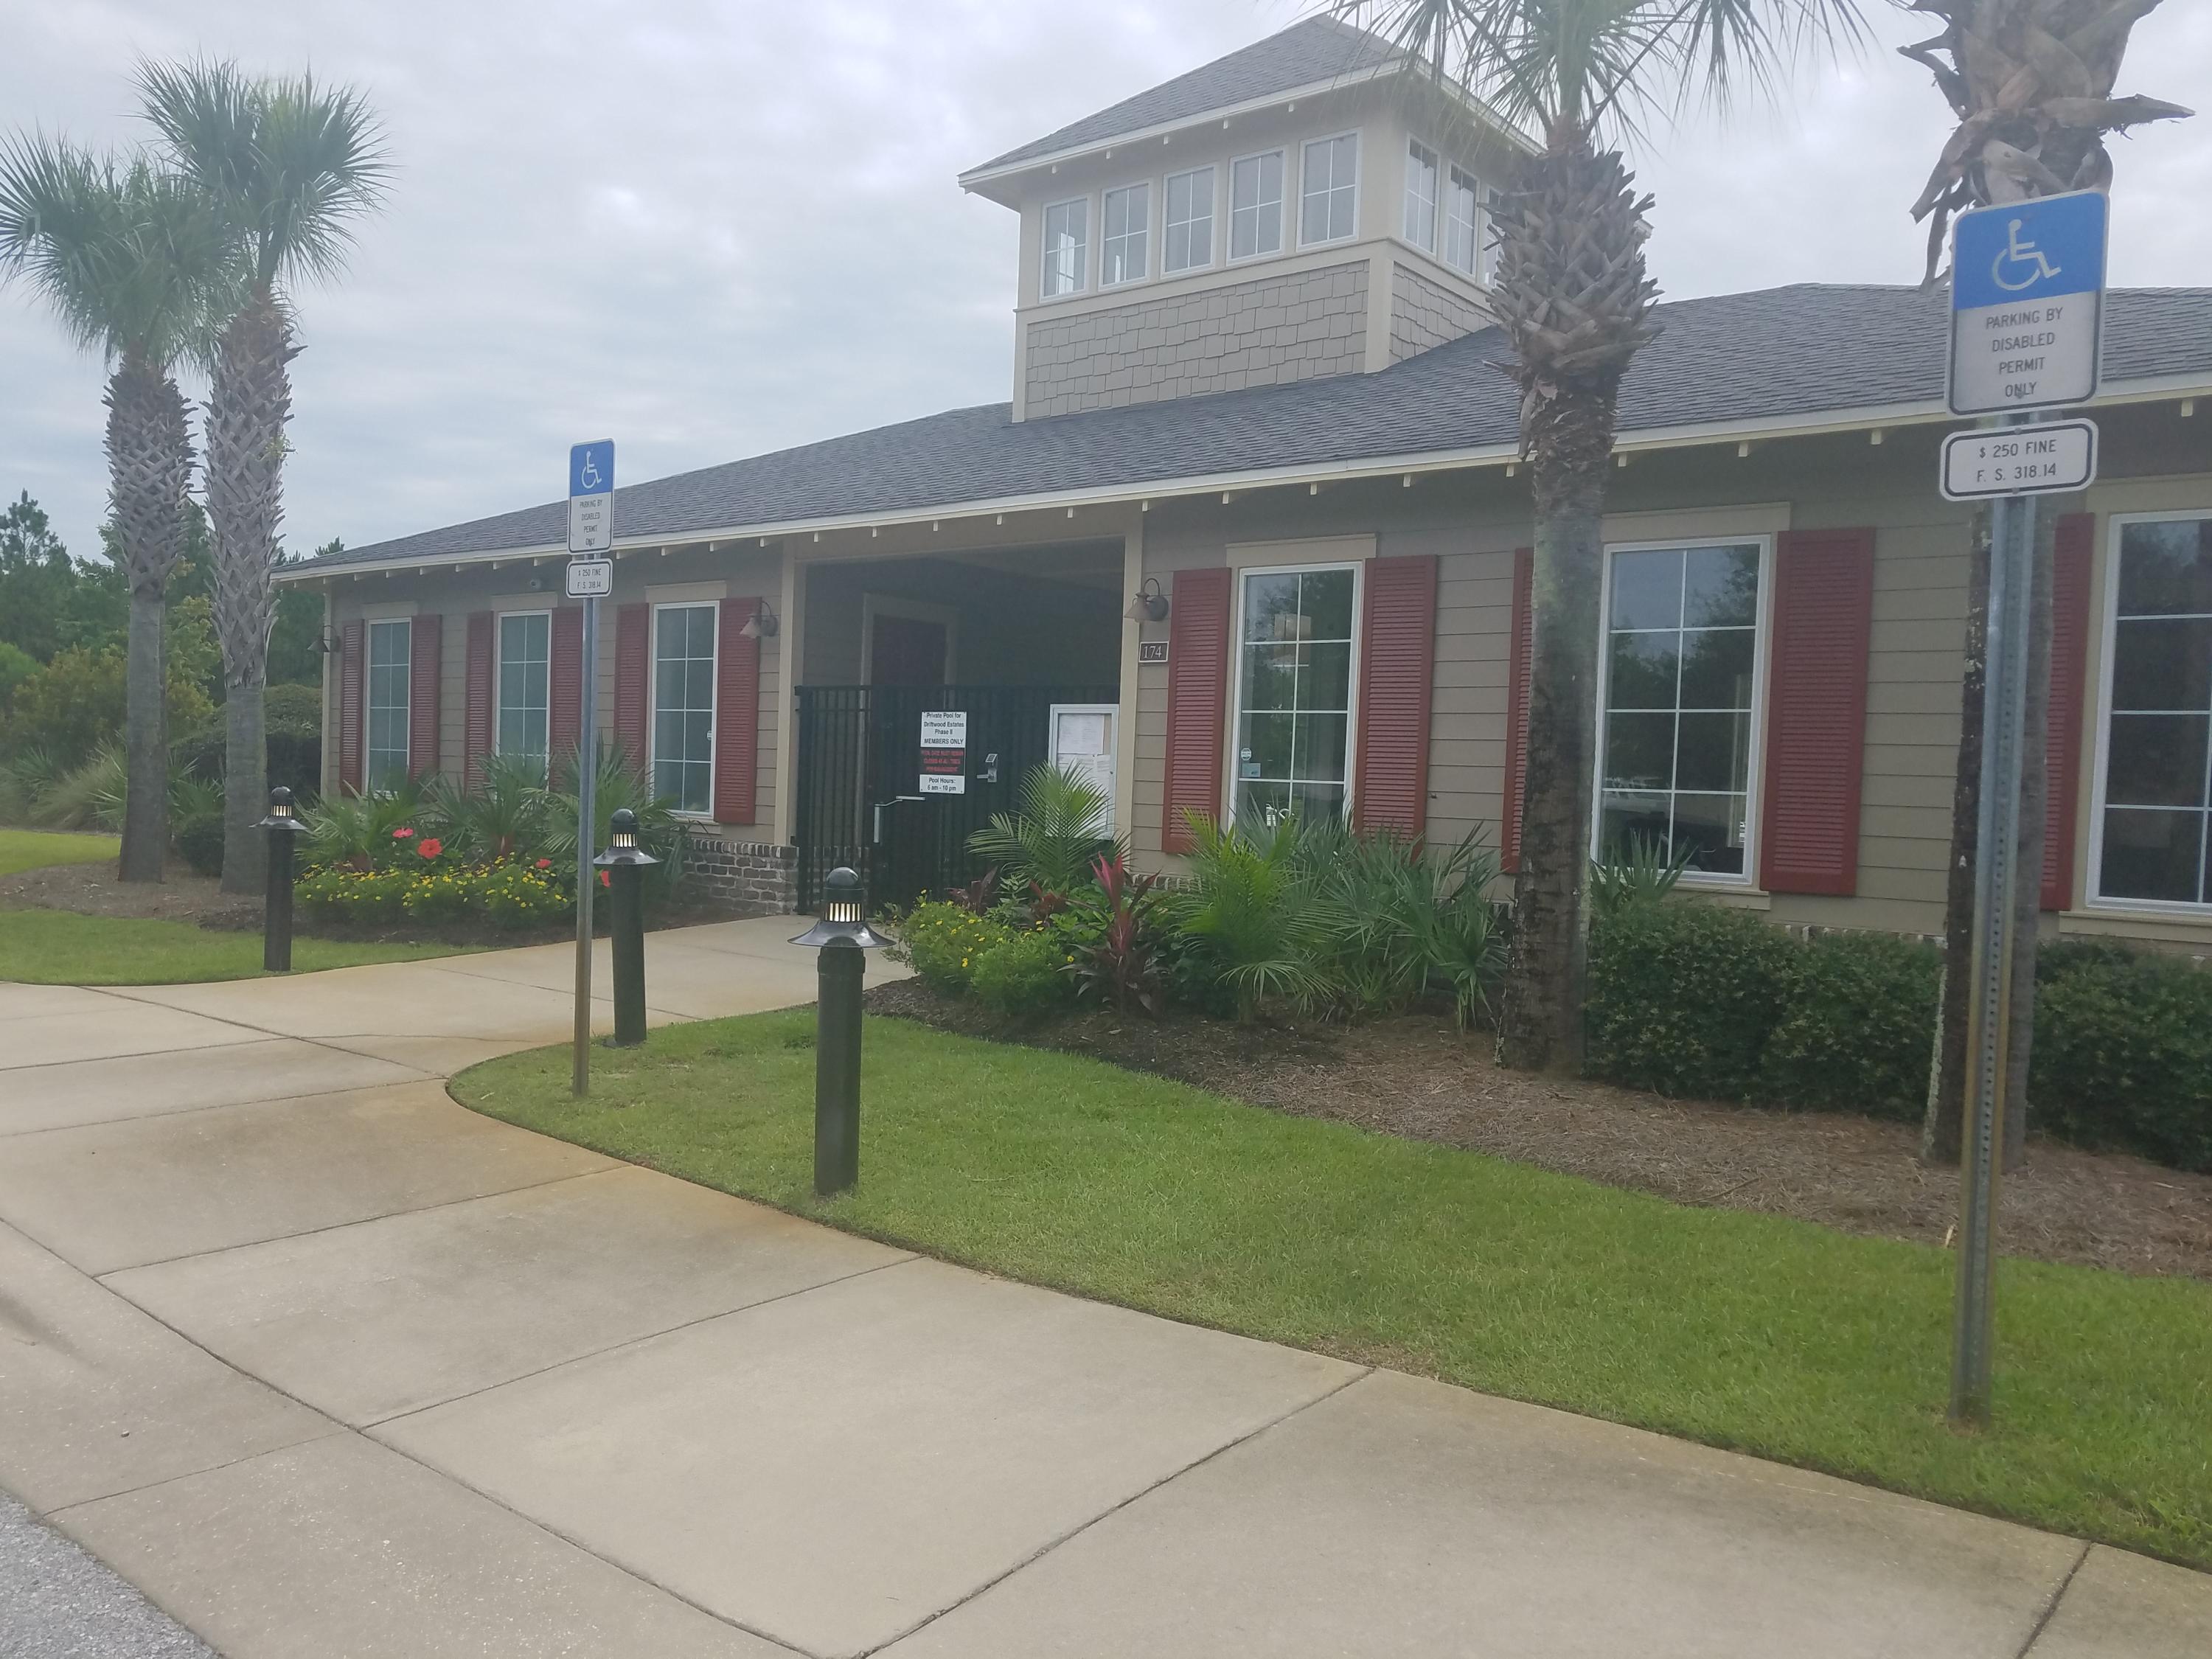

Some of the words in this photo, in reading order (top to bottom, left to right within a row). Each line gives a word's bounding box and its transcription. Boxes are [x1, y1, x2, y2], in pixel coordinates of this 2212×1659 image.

[1986, 310, 2040, 329] PARKING
[2046, 307, 2064, 321] BY
[1992, 332, 2055, 352] DISABLED
[1999, 357, 2045, 375] PERMIT
[2005, 382, 2037, 398] ONLY
[1979, 446, 1986, 459] $
[1992, 442, 2019, 459] 250
[2025, 439, 2057, 455] FINE
[1977, 470, 1986, 482] F.
[1994, 468, 2006, 481] S.
[2014, 463, 2056, 479] 318.14
[579, 499, 596, 508] PARKING
[597, 498, 602, 507] BY
[581, 512, 601, 521] DISABLED
[583, 524, 597, 533] PERMIT
[585, 538, 595, 546] ONLY
[582, 568, 591, 577] 250
[591, 568, 602, 576] FINE
[1144, 645, 1162, 658] 174
